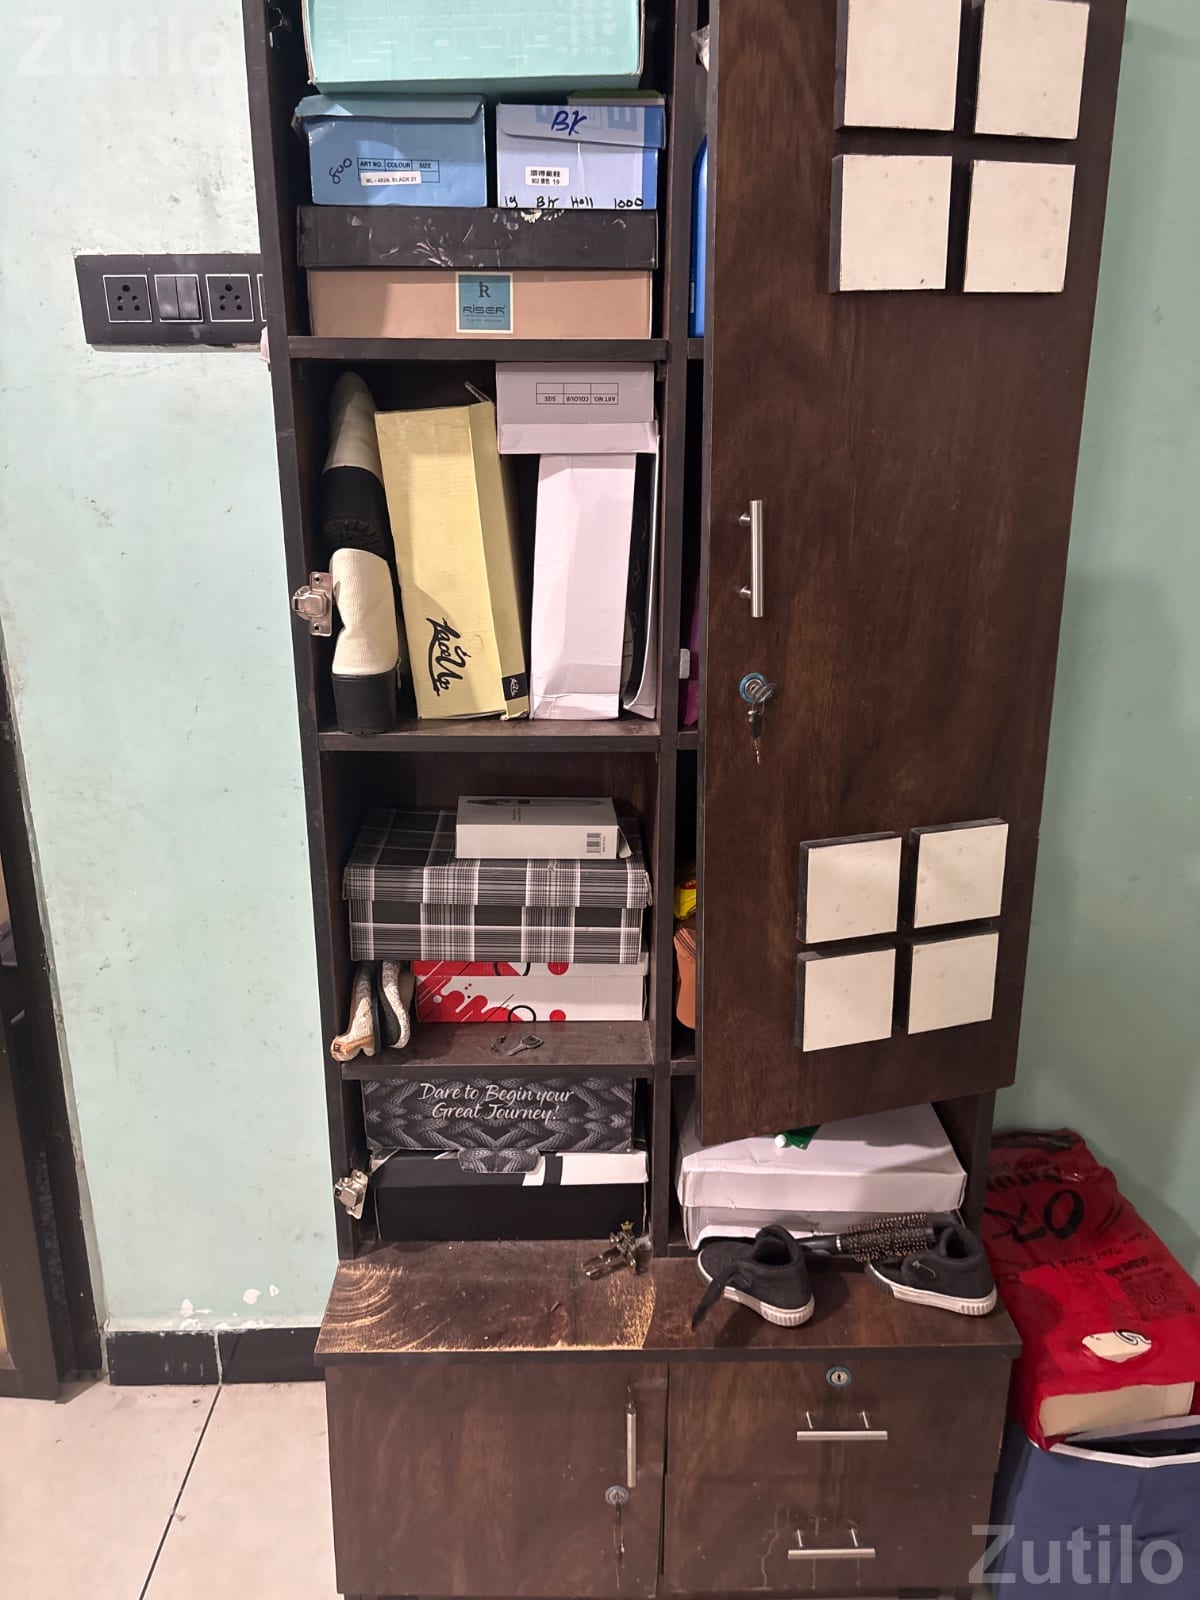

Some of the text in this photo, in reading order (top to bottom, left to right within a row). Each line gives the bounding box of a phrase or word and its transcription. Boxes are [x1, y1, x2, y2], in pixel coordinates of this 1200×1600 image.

[614, 197, 644, 209] 1000
[418, 1082, 574, 1111] Dare to Begin your
[431, 1102, 560, 1125] Great Journey!
